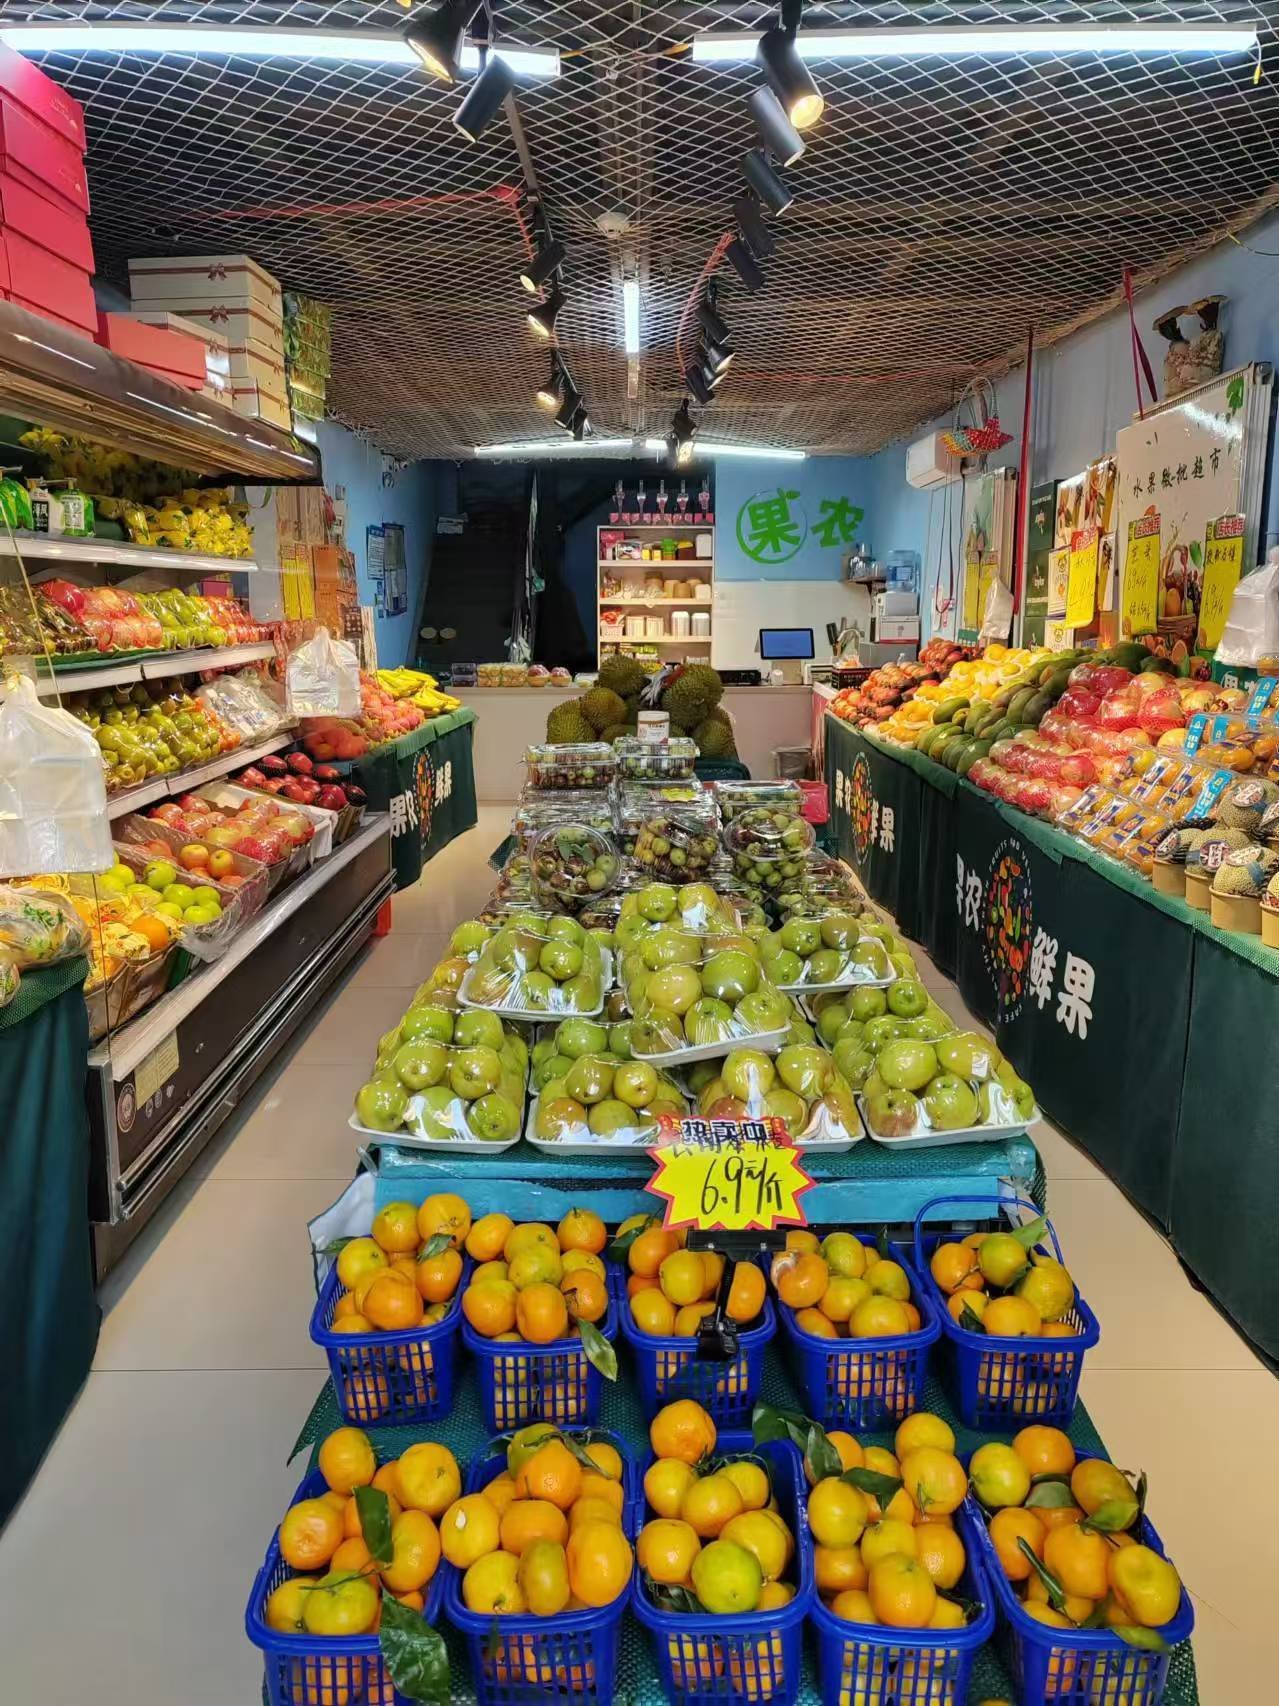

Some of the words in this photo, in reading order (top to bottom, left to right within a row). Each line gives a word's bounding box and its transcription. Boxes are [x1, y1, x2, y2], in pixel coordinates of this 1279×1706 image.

[744, 488, 865, 557] 果农
[434, 760, 452, 807] 鲜果
[870, 798, 895, 853] 鲜果
[1030, 926, 1095, 1040] 鲜果
[681, 1119, 770, 1145] 热卖中
